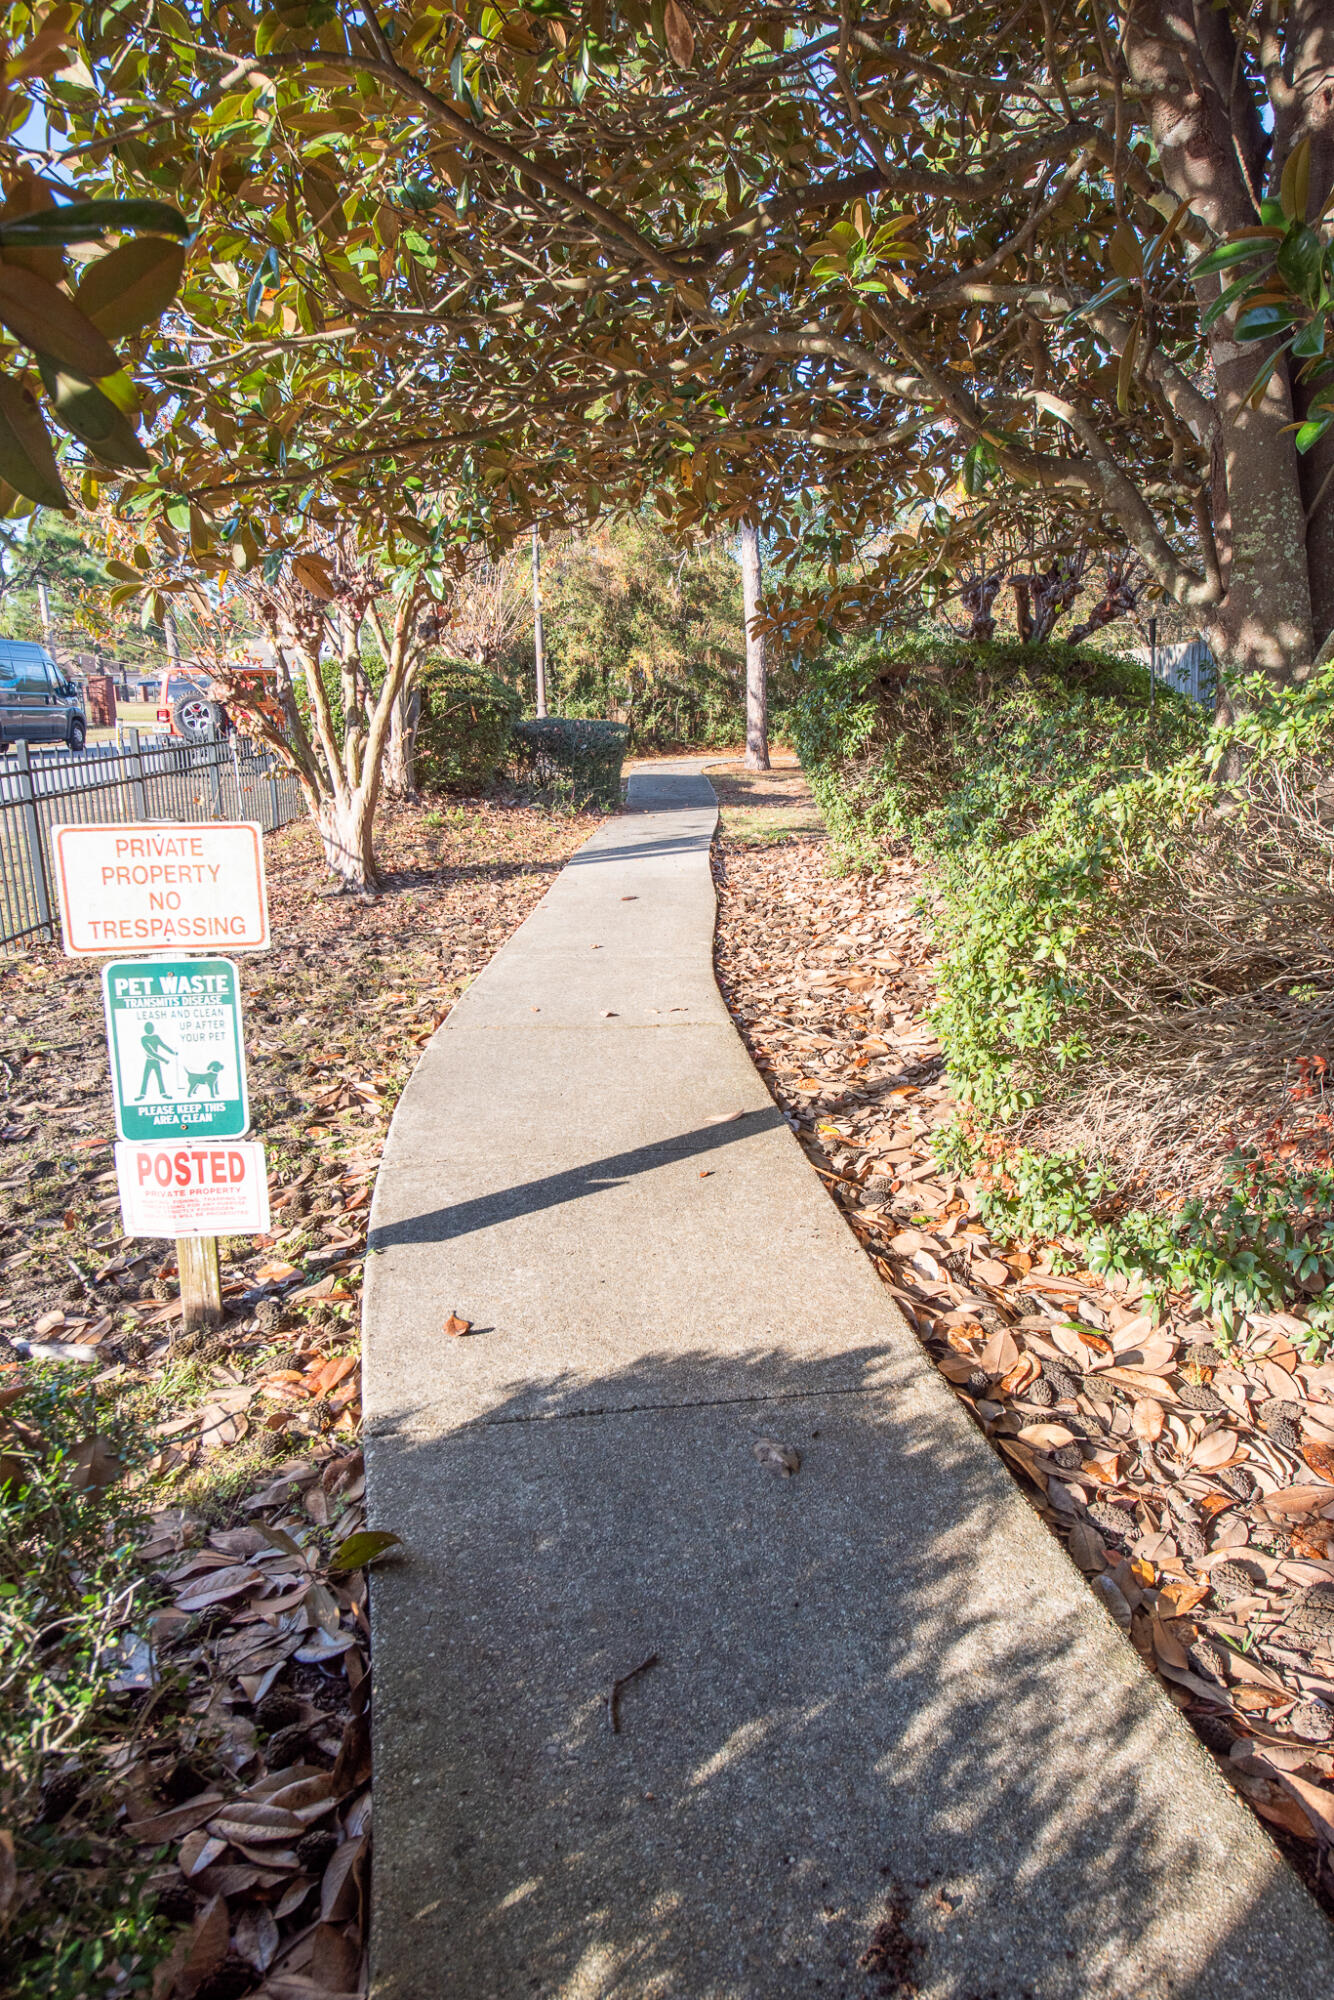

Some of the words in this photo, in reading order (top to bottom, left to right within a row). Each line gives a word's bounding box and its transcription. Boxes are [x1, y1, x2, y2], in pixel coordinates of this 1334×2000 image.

[116, 838, 204, 858] PRIVATE
[101, 864, 221, 886] PROPERTY
[149, 891, 182, 911] NO
[88, 916, 246, 940] TRESPASSING
[114, 977, 154, 996] PET
[159, 974, 229, 994] WASTE
[123, 996, 180, 1008] TRANSMITS
[182, 995, 223, 1006] DISEASE
[137, 1010, 167, 1020] LEASH
[171, 1009, 190, 1019] AND
[193, 1008, 224, 1018] CLEAN
[179, 1021, 192, 1031] UP
[196, 1020, 225, 1030] AFTER
[180, 1033, 205, 1042] YOUR
[209, 1032, 226, 1041] PET
[138, 1105, 175, 1116] PLEASE
[177, 1104, 202, 1114] KEEP
[203, 1102, 226, 1112] THIS
[153, 1115, 180, 1125] AREA
[181, 1113, 213, 1123] CLEAN
[136, 1151, 246, 1187] POSTED
[145, 1189, 186, 1198] PRIVATE
[189, 1187, 241, 1196] PROPERTY
